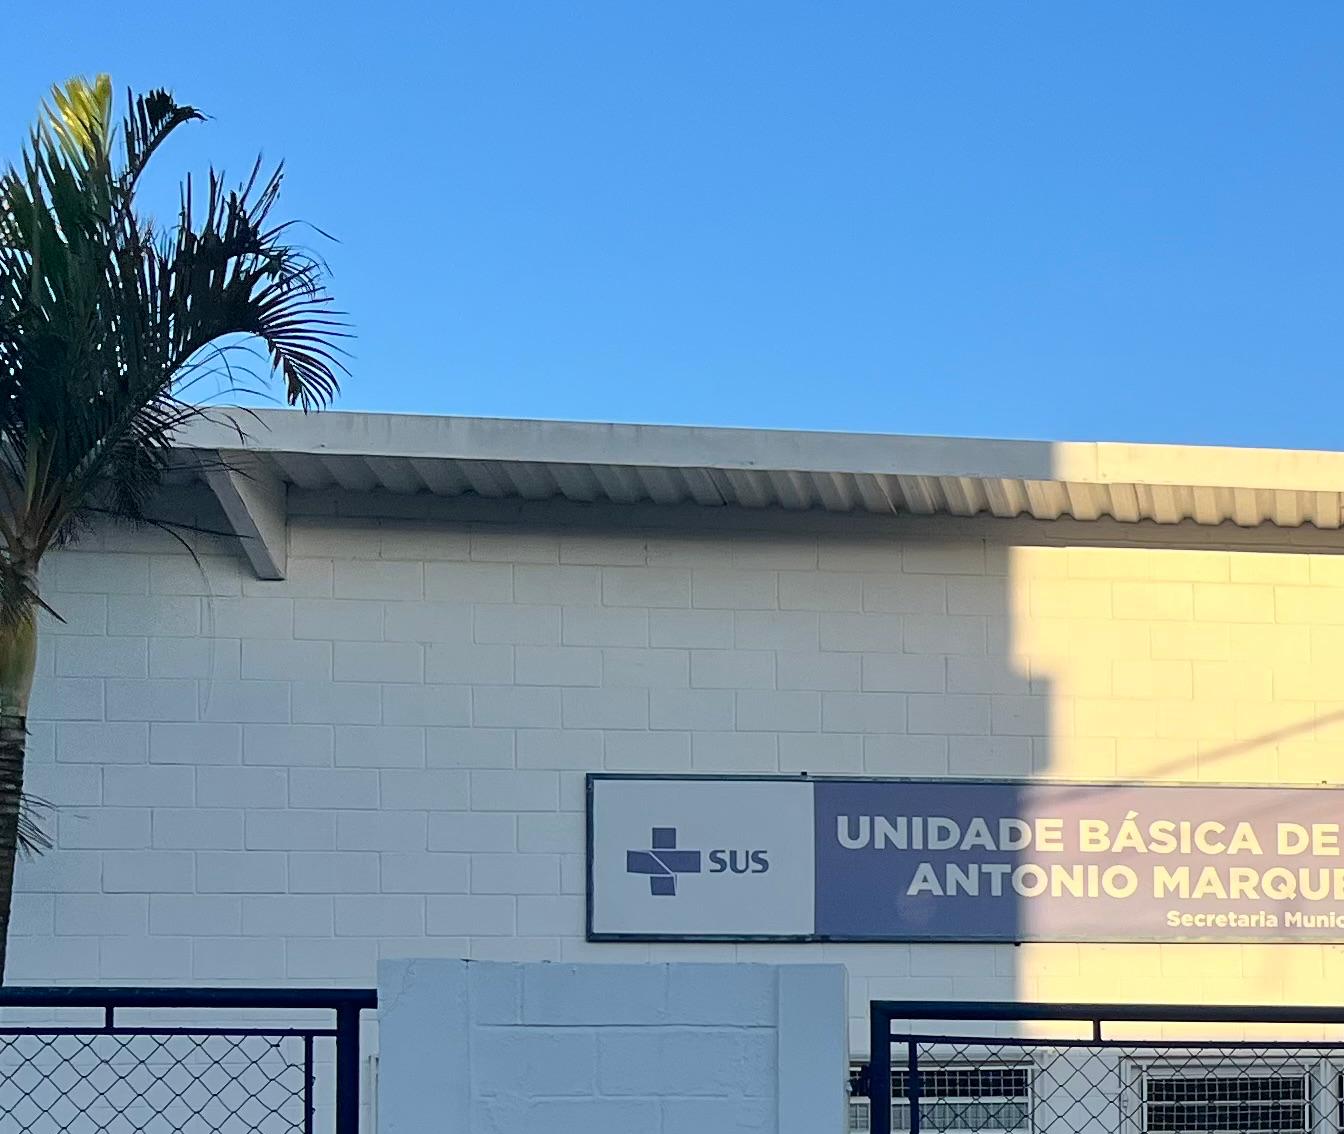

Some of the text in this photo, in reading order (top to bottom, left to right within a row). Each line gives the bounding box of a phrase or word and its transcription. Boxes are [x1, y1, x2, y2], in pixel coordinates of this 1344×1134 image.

[836, 815, 1064, 852] UNIDADE
[1078, 810, 1264, 855] BÁSICA
[1276, 822, 1341, 856] DE
[708, 849, 770, 874] SUS
[906, 862, 1139, 899] ANTONIO
[1166, 909, 1279, 929] Secretaria
